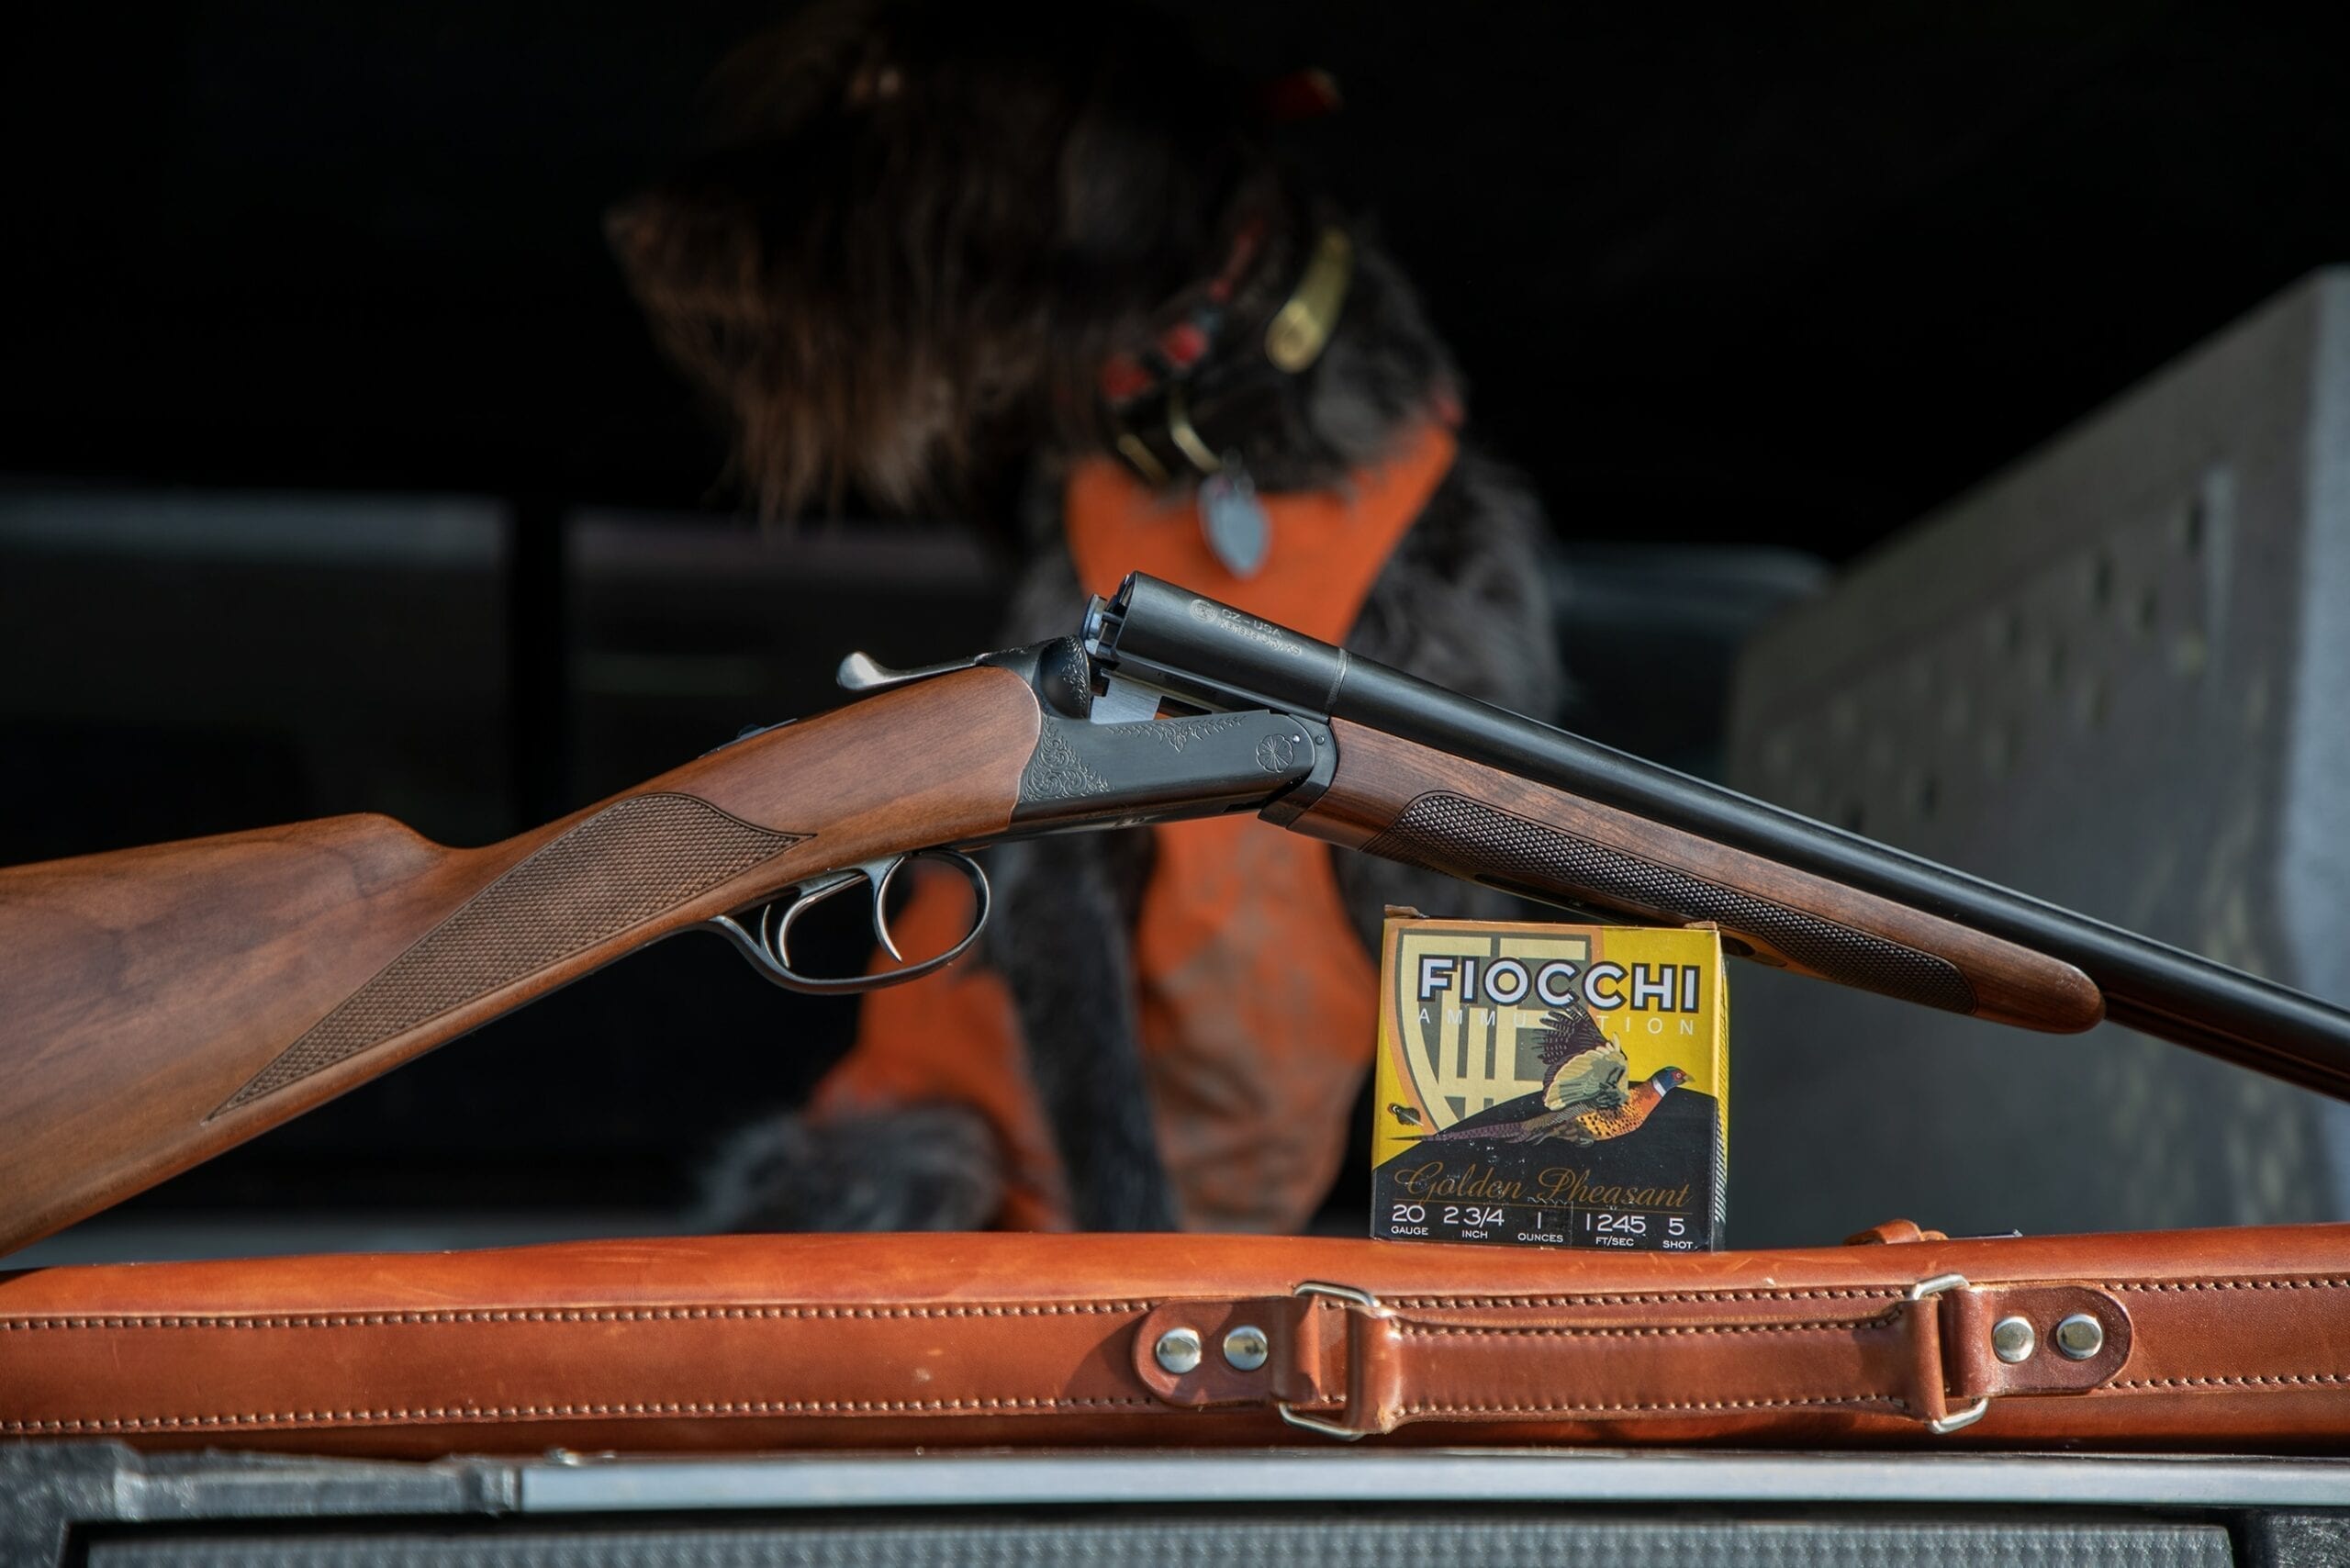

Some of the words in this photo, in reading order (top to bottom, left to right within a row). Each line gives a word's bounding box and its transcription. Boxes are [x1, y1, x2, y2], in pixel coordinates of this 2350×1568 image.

[1417, 955, 1700, 1014] FIOCCHI
[1418, 1007, 1695, 1036] AMMUTION
[1395, 1162, 1526, 1205] Golden
[1537, 1167, 1694, 1208] Pheasant
[1392, 1204, 1426, 1224] 20
[1585, 1214, 1646, 1235] 1245
[1669, 1218, 1684, 1235] 5
[1391, 1226, 1428, 1236] GAUGE
[1461, 1229, 1488, 1239] INCH
[1517, 1232, 1563, 1243] OUNCES
[1595, 1237, 1634, 1247] FT/SEC
[1662, 1239, 1693, 1249] SHOT
